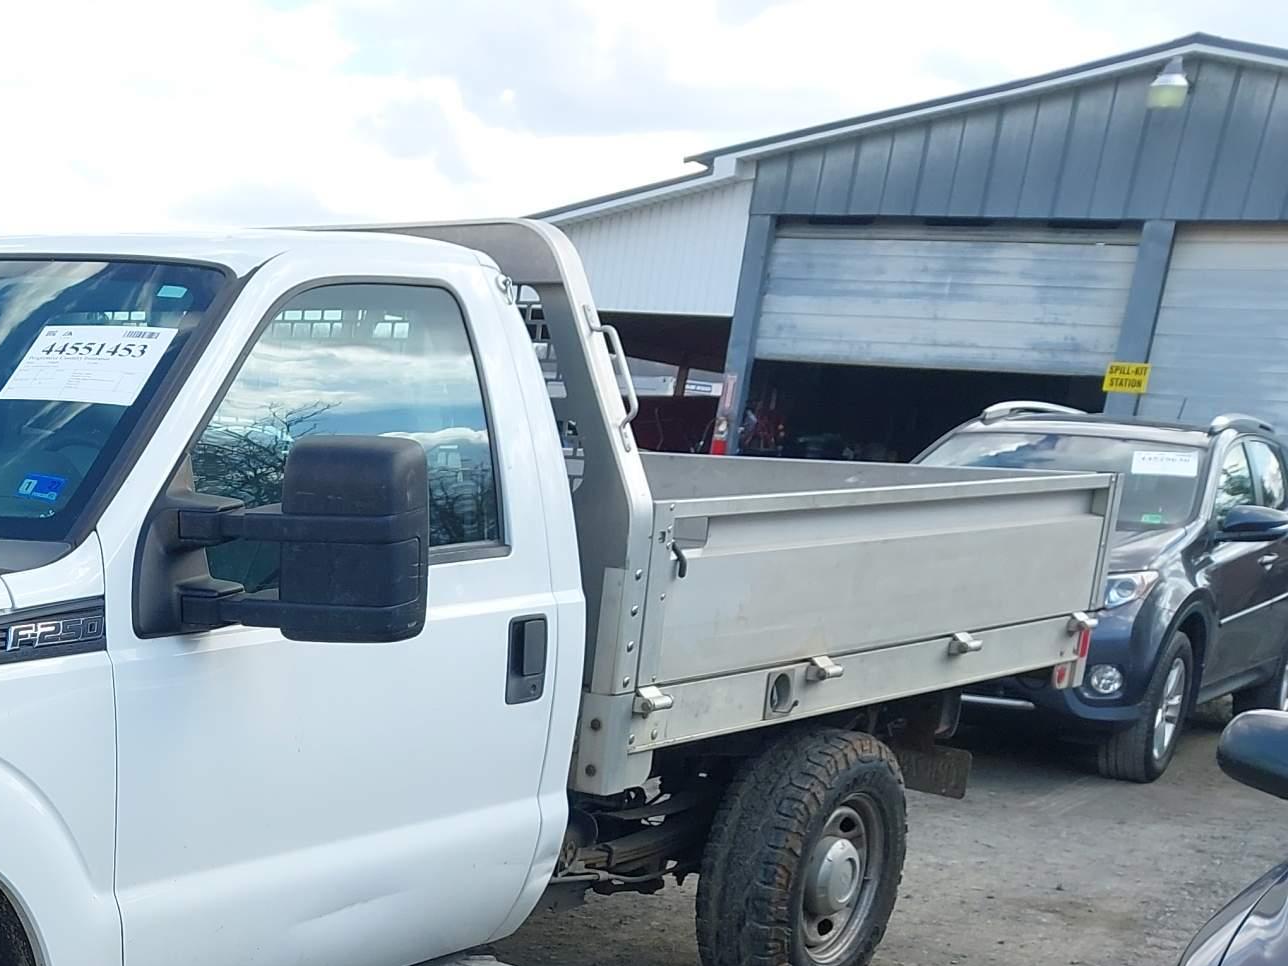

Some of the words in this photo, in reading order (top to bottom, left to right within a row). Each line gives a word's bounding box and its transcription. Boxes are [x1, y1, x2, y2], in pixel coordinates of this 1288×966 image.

[42, 342, 149, 358] 44551453
[1109, 365, 1148, 376] SPILL-KIT
[1109, 377, 1143, 388] STATION
[6, 616, 105, 652] F-250
